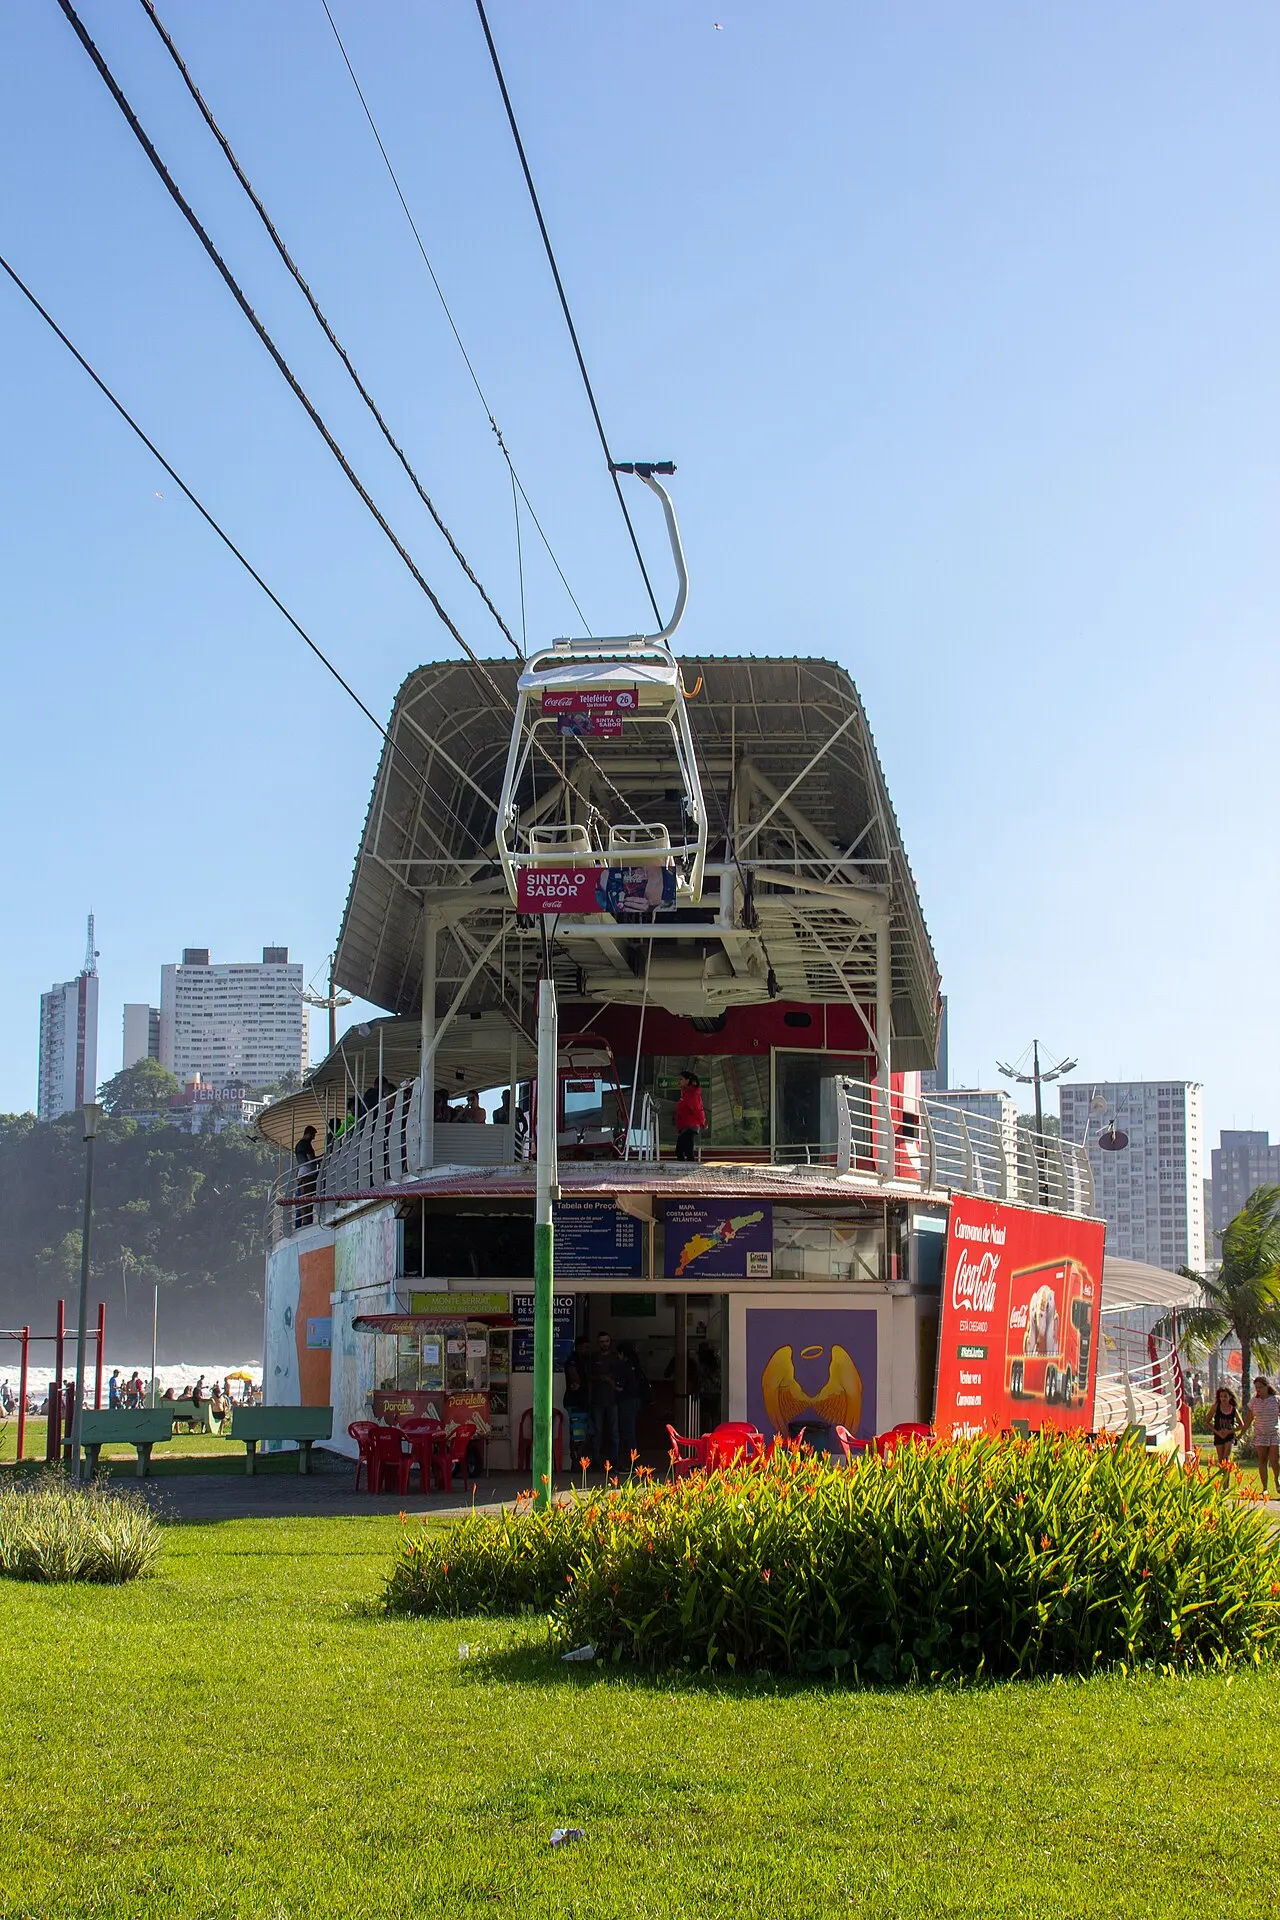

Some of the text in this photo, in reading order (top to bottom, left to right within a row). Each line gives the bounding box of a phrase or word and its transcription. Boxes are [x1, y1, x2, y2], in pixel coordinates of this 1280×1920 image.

[579, 694, 612, 703] Teleférico
[526, 873, 586, 885] SINTA O
[526, 885, 578, 897] SABOR
[954, 1216, 1006, 1246] Caravana de Natal
[750, 1252, 768, 1262] Costa
[952, 1248, 1000, 1312] Coca-Cola
[431, 1297, 490, 1305] MONTE SERRAT
